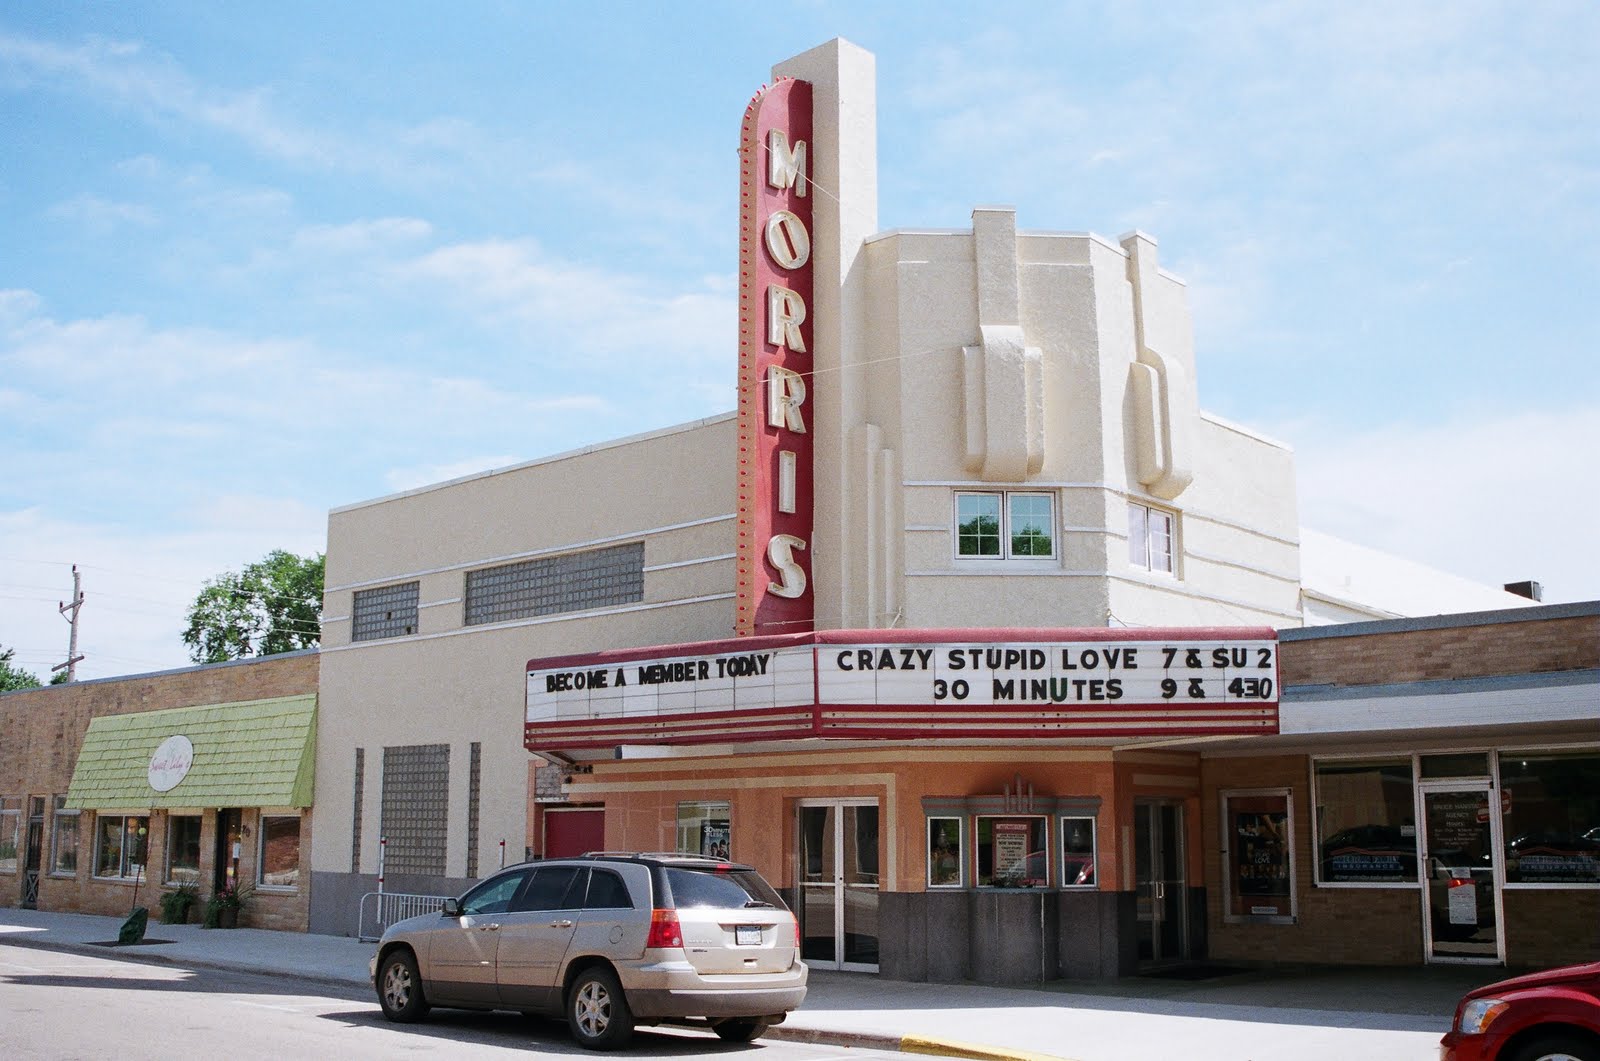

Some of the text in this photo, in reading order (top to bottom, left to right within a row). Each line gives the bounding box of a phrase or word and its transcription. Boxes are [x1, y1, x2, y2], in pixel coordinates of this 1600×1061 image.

[765, 127, 811, 599] MORRIS
[546, 653, 770, 693] BECOME A MEMBER TODAY
[837, 647, 1272, 671] CRAZY STUPID LOVE 7 & SU 2
[933, 678, 970, 700] 30
[992, 677, 1123, 702] MINUTES
[1160, 677, 1178, 700] 9
[1187, 677, 1206, 699] &
